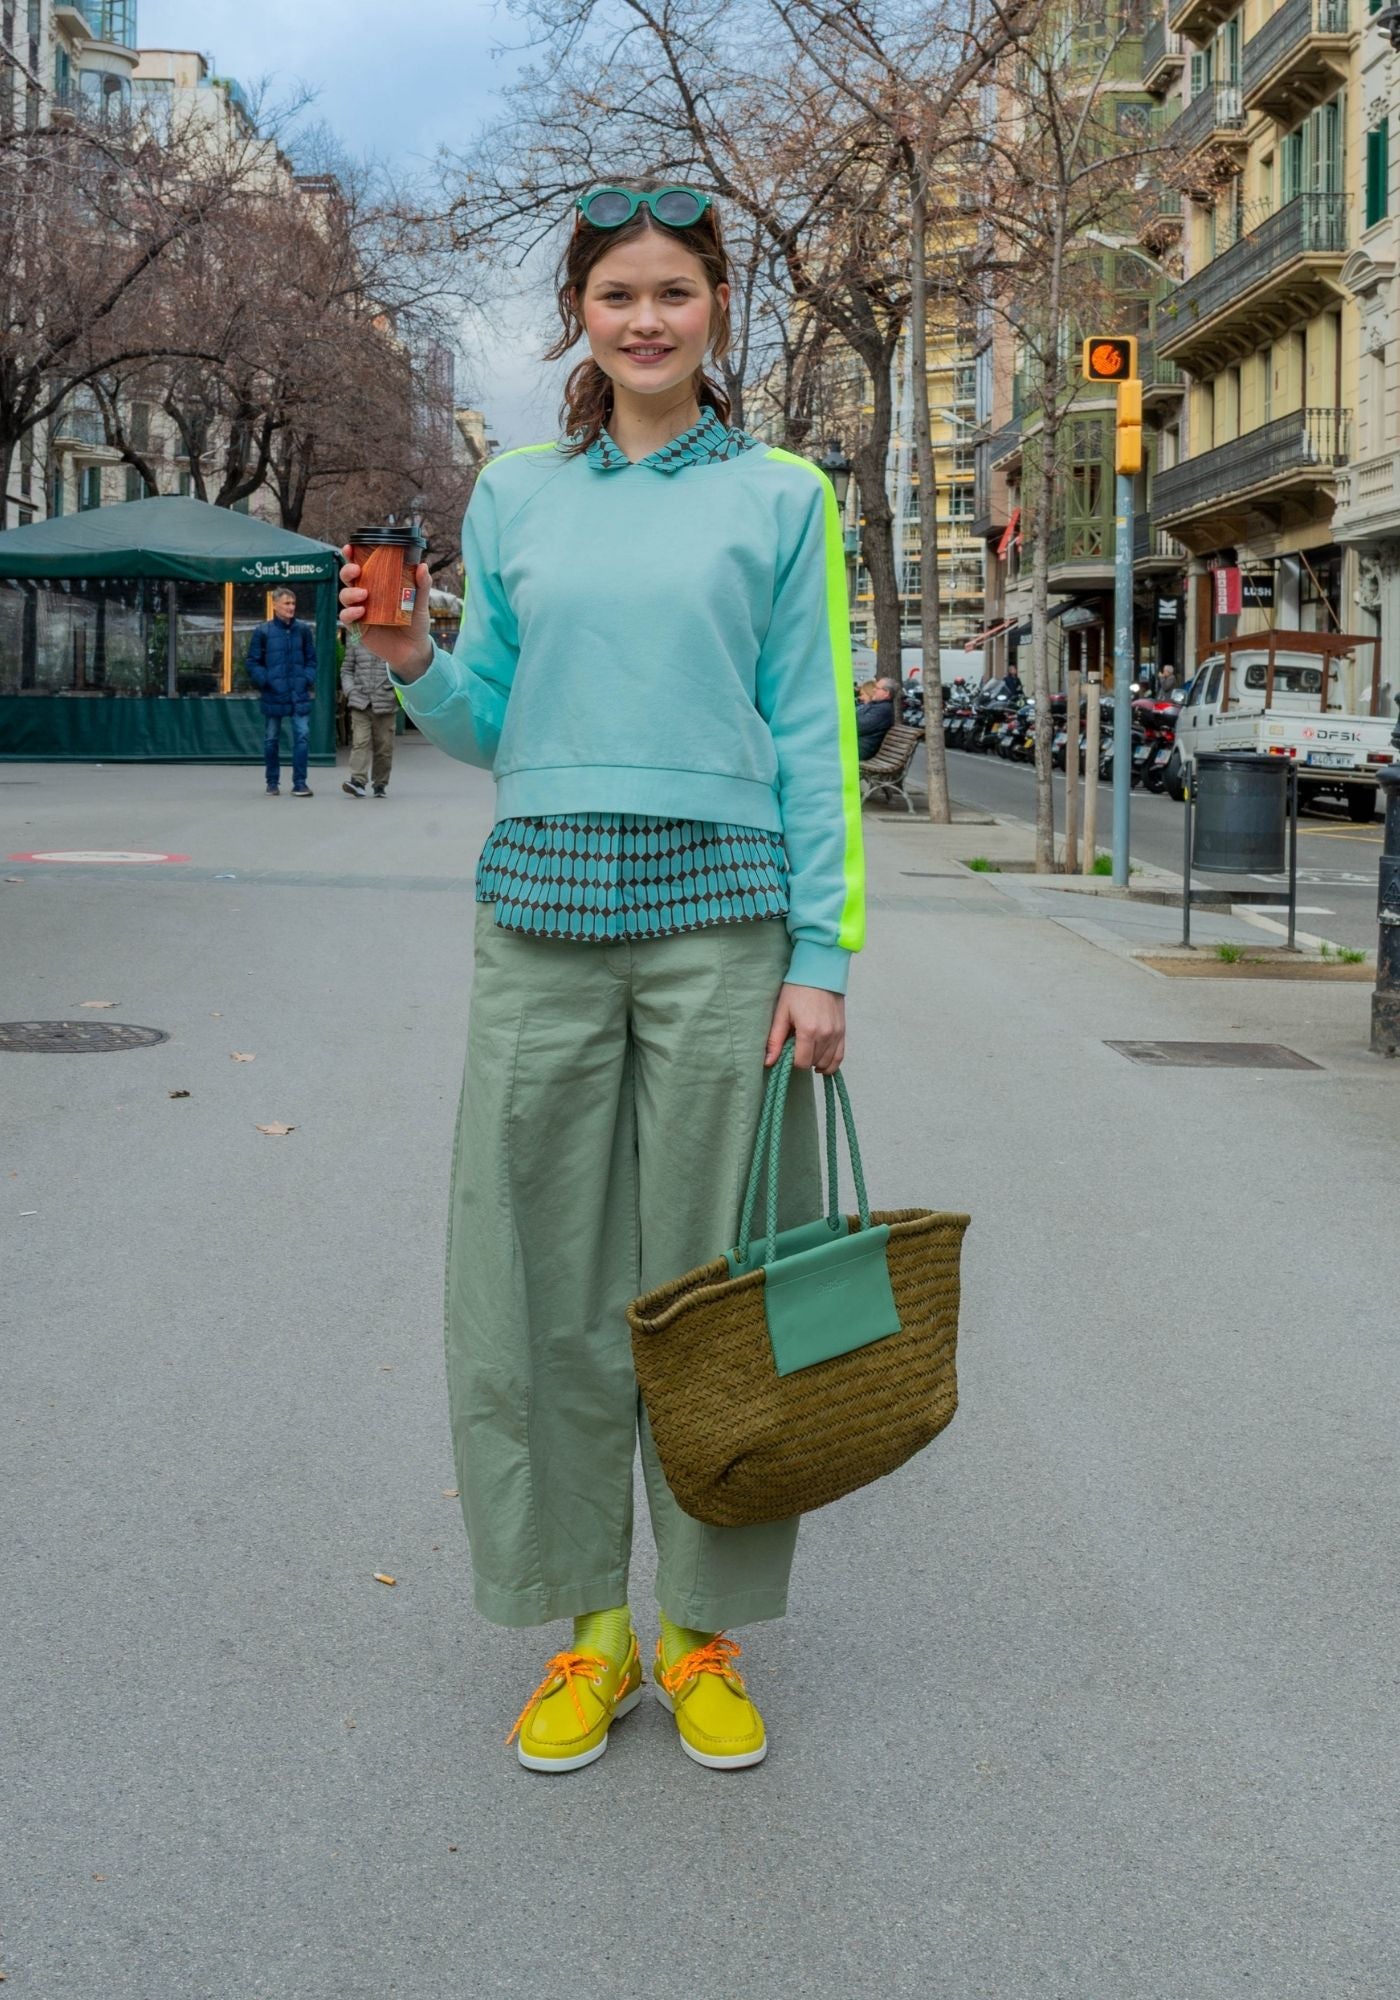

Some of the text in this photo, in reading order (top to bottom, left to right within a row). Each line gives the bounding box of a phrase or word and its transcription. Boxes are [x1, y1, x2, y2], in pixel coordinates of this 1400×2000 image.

[255, 561, 315, 578] Sant Jaume
[1243, 586, 1272, 597] LUSH
[1317, 730, 1361, 742] DFSK
